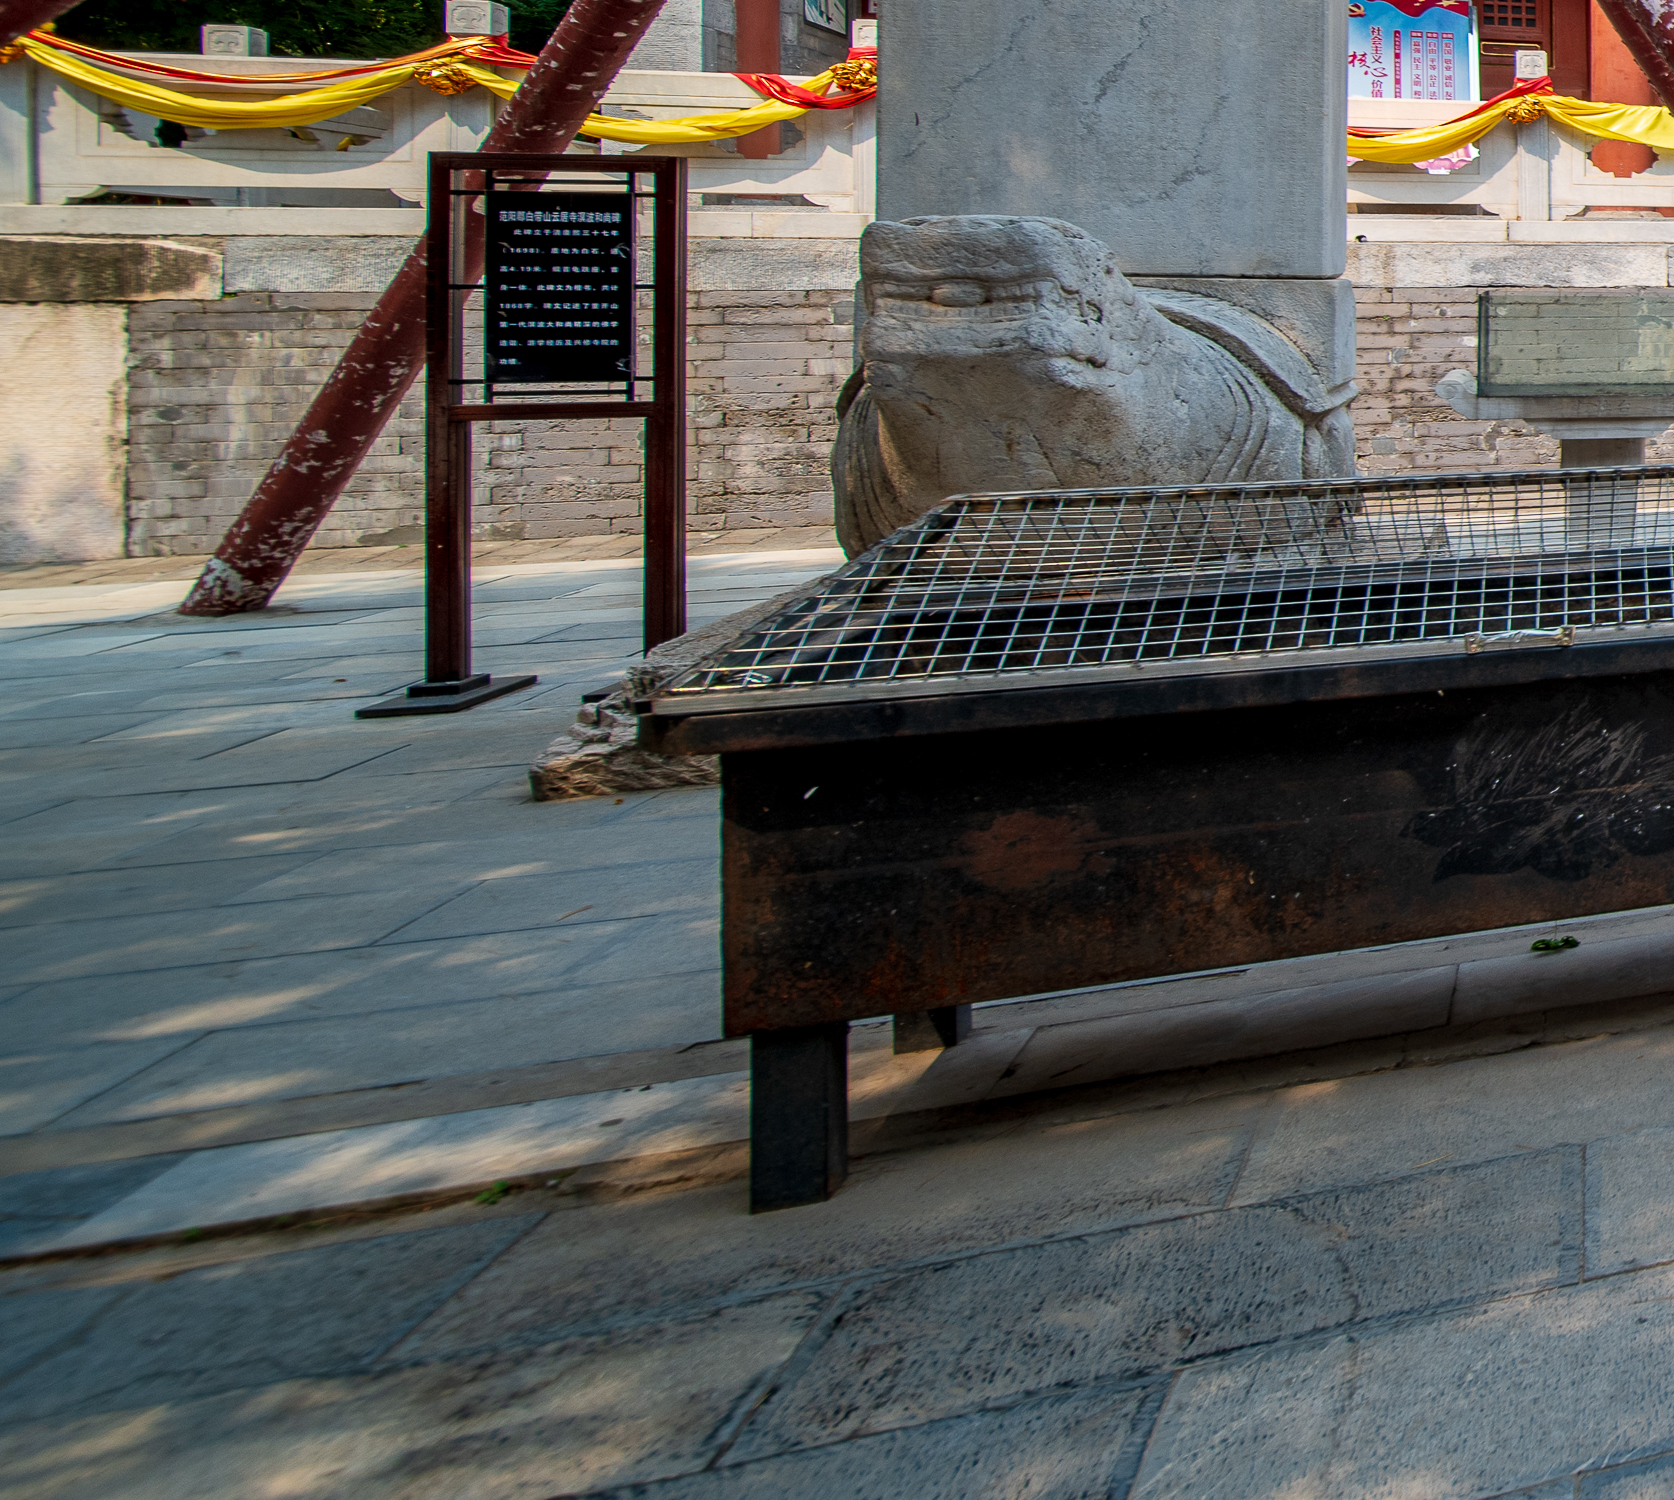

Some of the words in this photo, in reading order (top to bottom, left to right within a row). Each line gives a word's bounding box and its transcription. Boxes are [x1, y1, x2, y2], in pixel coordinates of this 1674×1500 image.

[1370, 26, 1383, 64] 社会主义
[1428, 41, 1437, 54] 自由
[1443, 42, 1452, 55] 爱国
[1413, 57, 1421, 70] 民主
[1429, 58, 1437, 71] 平等
[1429, 74, 1437, 87] 公正
